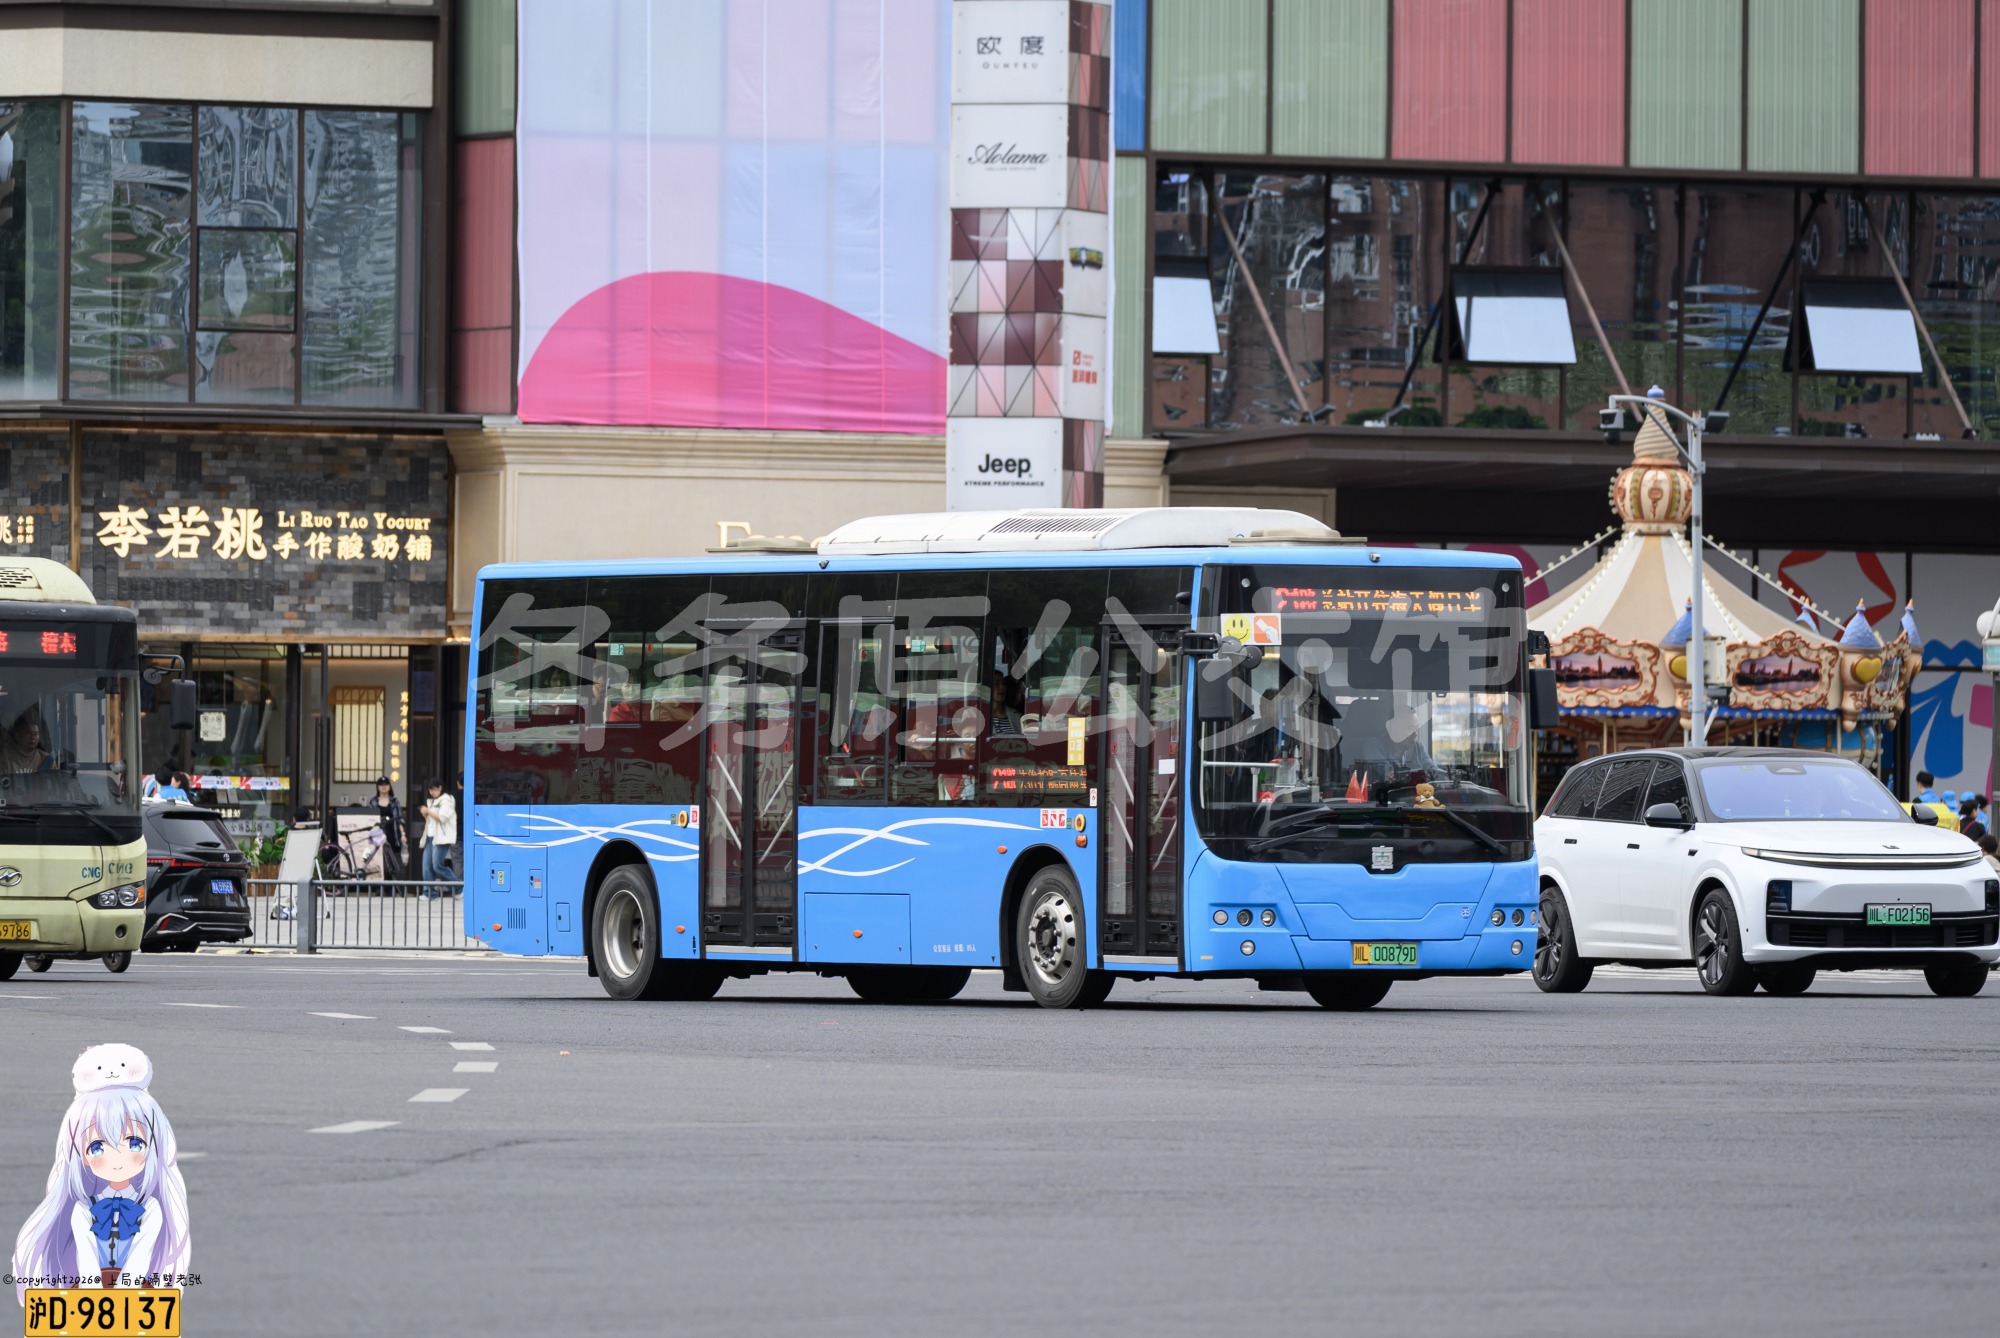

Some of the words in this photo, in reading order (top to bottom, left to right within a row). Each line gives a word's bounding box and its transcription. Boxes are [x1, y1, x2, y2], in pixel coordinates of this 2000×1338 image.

[978, 453, 1031, 478] Jeep
[96, 504, 267, 560] 李若桃
[272, 531, 432, 561] 手作酸奶铺
[82, 867, 101, 879] CNG
